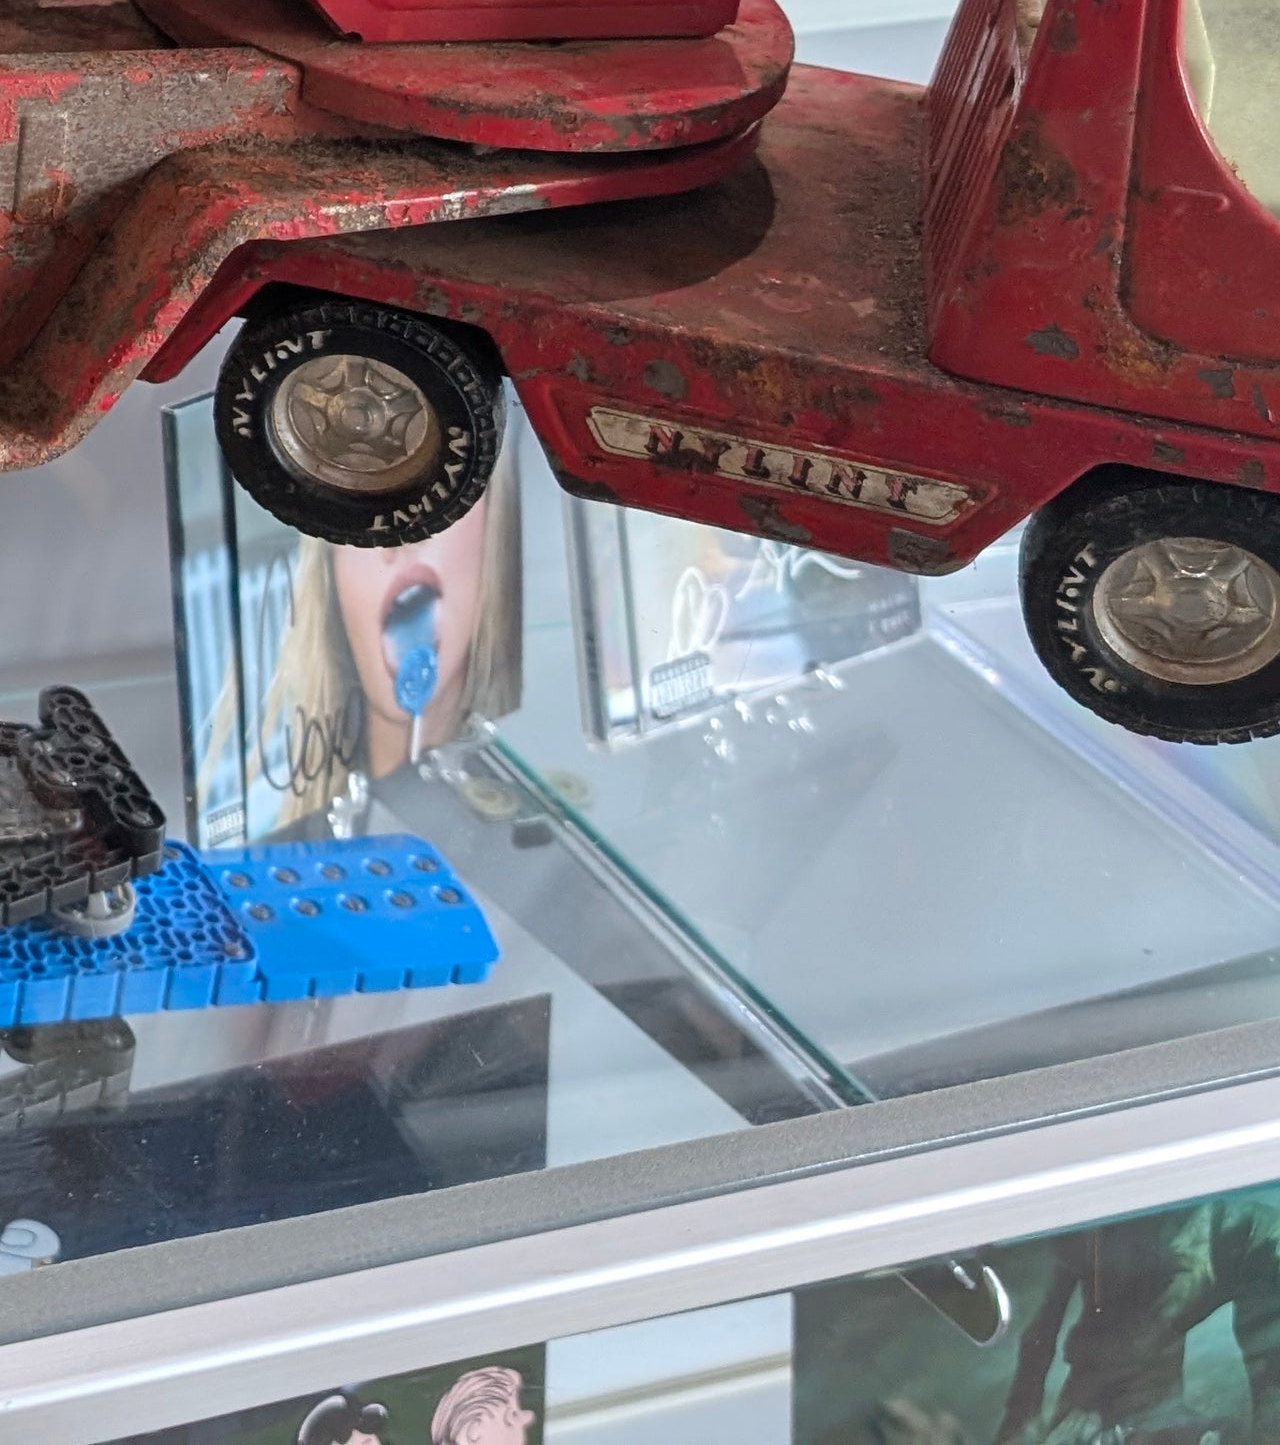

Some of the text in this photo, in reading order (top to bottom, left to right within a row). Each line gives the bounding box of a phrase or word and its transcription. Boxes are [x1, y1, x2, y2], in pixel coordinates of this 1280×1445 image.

[231, 329, 333, 438] NYLINT
[367, 425, 472, 533] NYLINT
[644, 423, 919, 511] NYLINT
